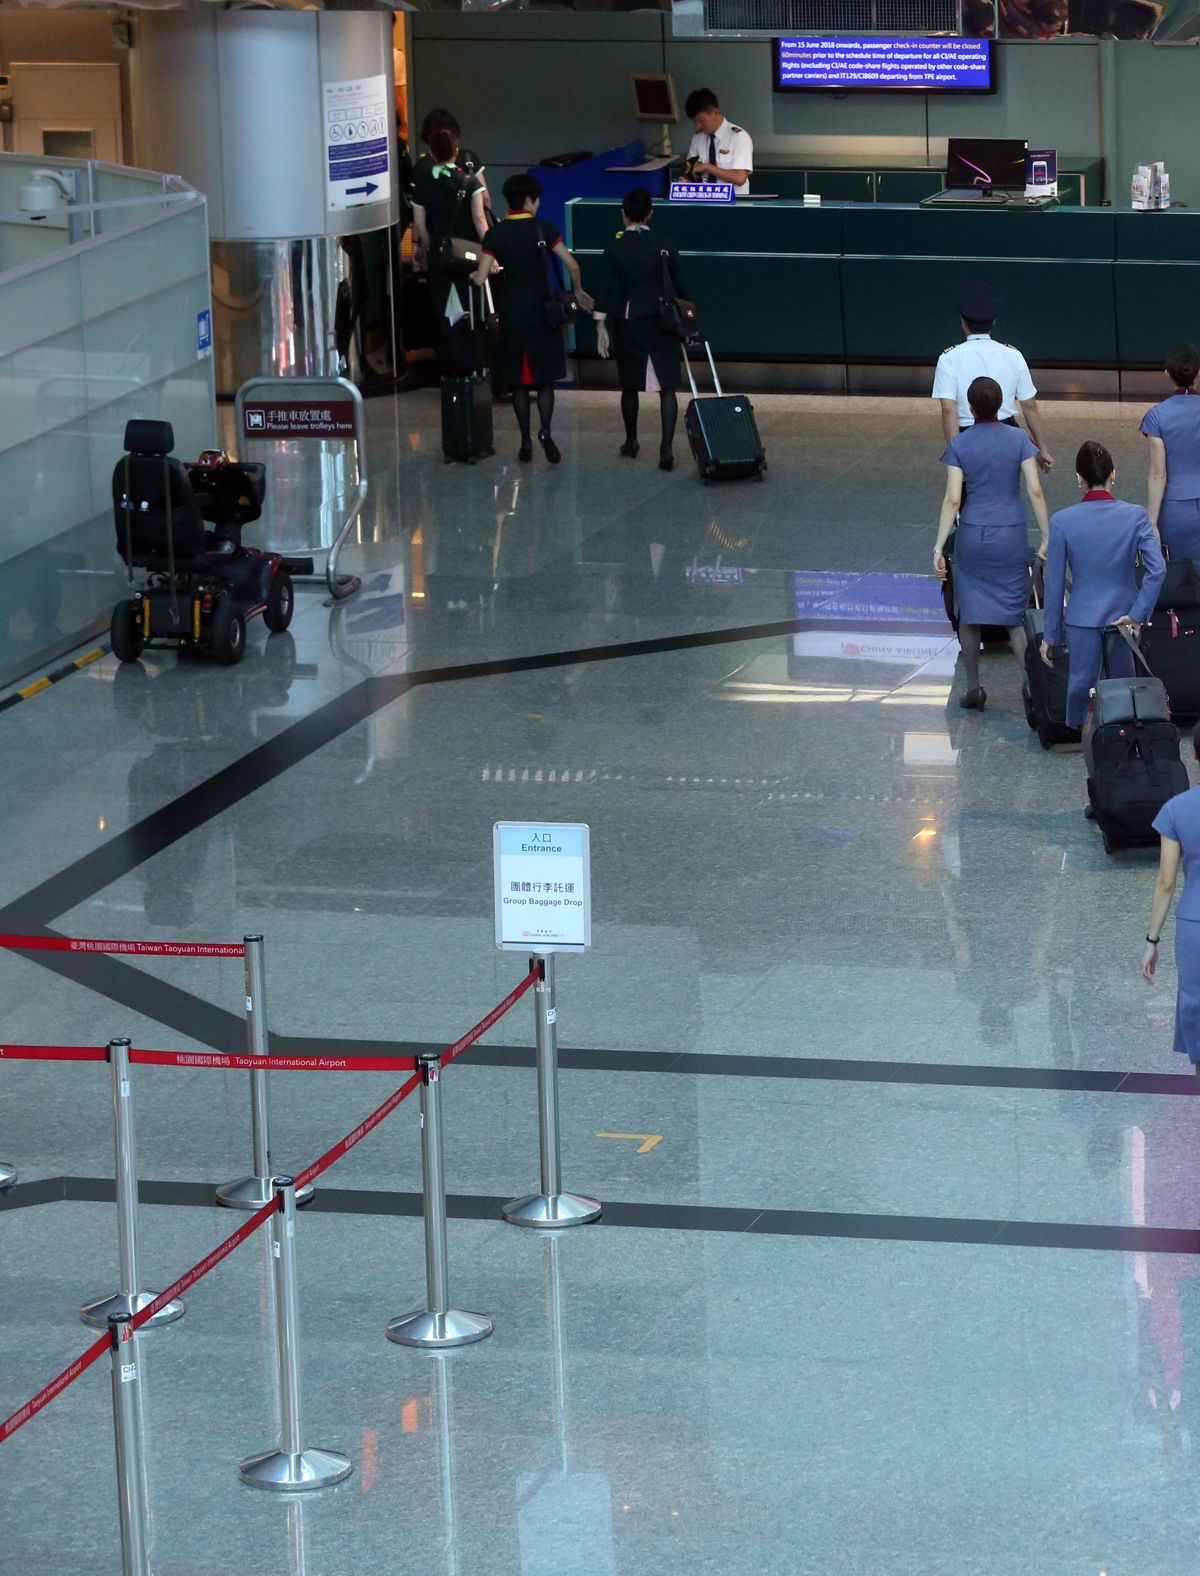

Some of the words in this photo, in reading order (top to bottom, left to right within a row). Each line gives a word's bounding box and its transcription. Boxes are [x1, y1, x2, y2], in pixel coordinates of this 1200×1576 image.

[893, 53, 922, 61] departure
[782, 62, 800, 70] flights
[801, 62, 831, 70] (excluding
[882, 63, 900, 71] flights
[900, 63, 927, 71] operated
[928, 63, 936, 71] by
[804, 72, 827, 80] carriers)
[879, 73, 908, 81] departing
[266, 422, 289, 430] Please
[290, 422, 309, 430] leave
[310, 422, 335, 431] trolleys
[531, 833, 552, 843] 入口
[521, 843, 562, 853] Entrance
[510, 881, 575, 893] 團體行李託運
[503, 897, 527, 906] Group
[529, 898, 562, 907] Baggage
[564, 899, 583, 907] Drop
[136, 943, 163, 952] Taiwan
[163, 944, 197, 953] Taoyuan
[197, 945, 244, 954] International
[235, 1056, 268, 1067] Taoyuan
[268, 1056, 318, 1066] International
[318, 1059, 347, 1068] Airport
